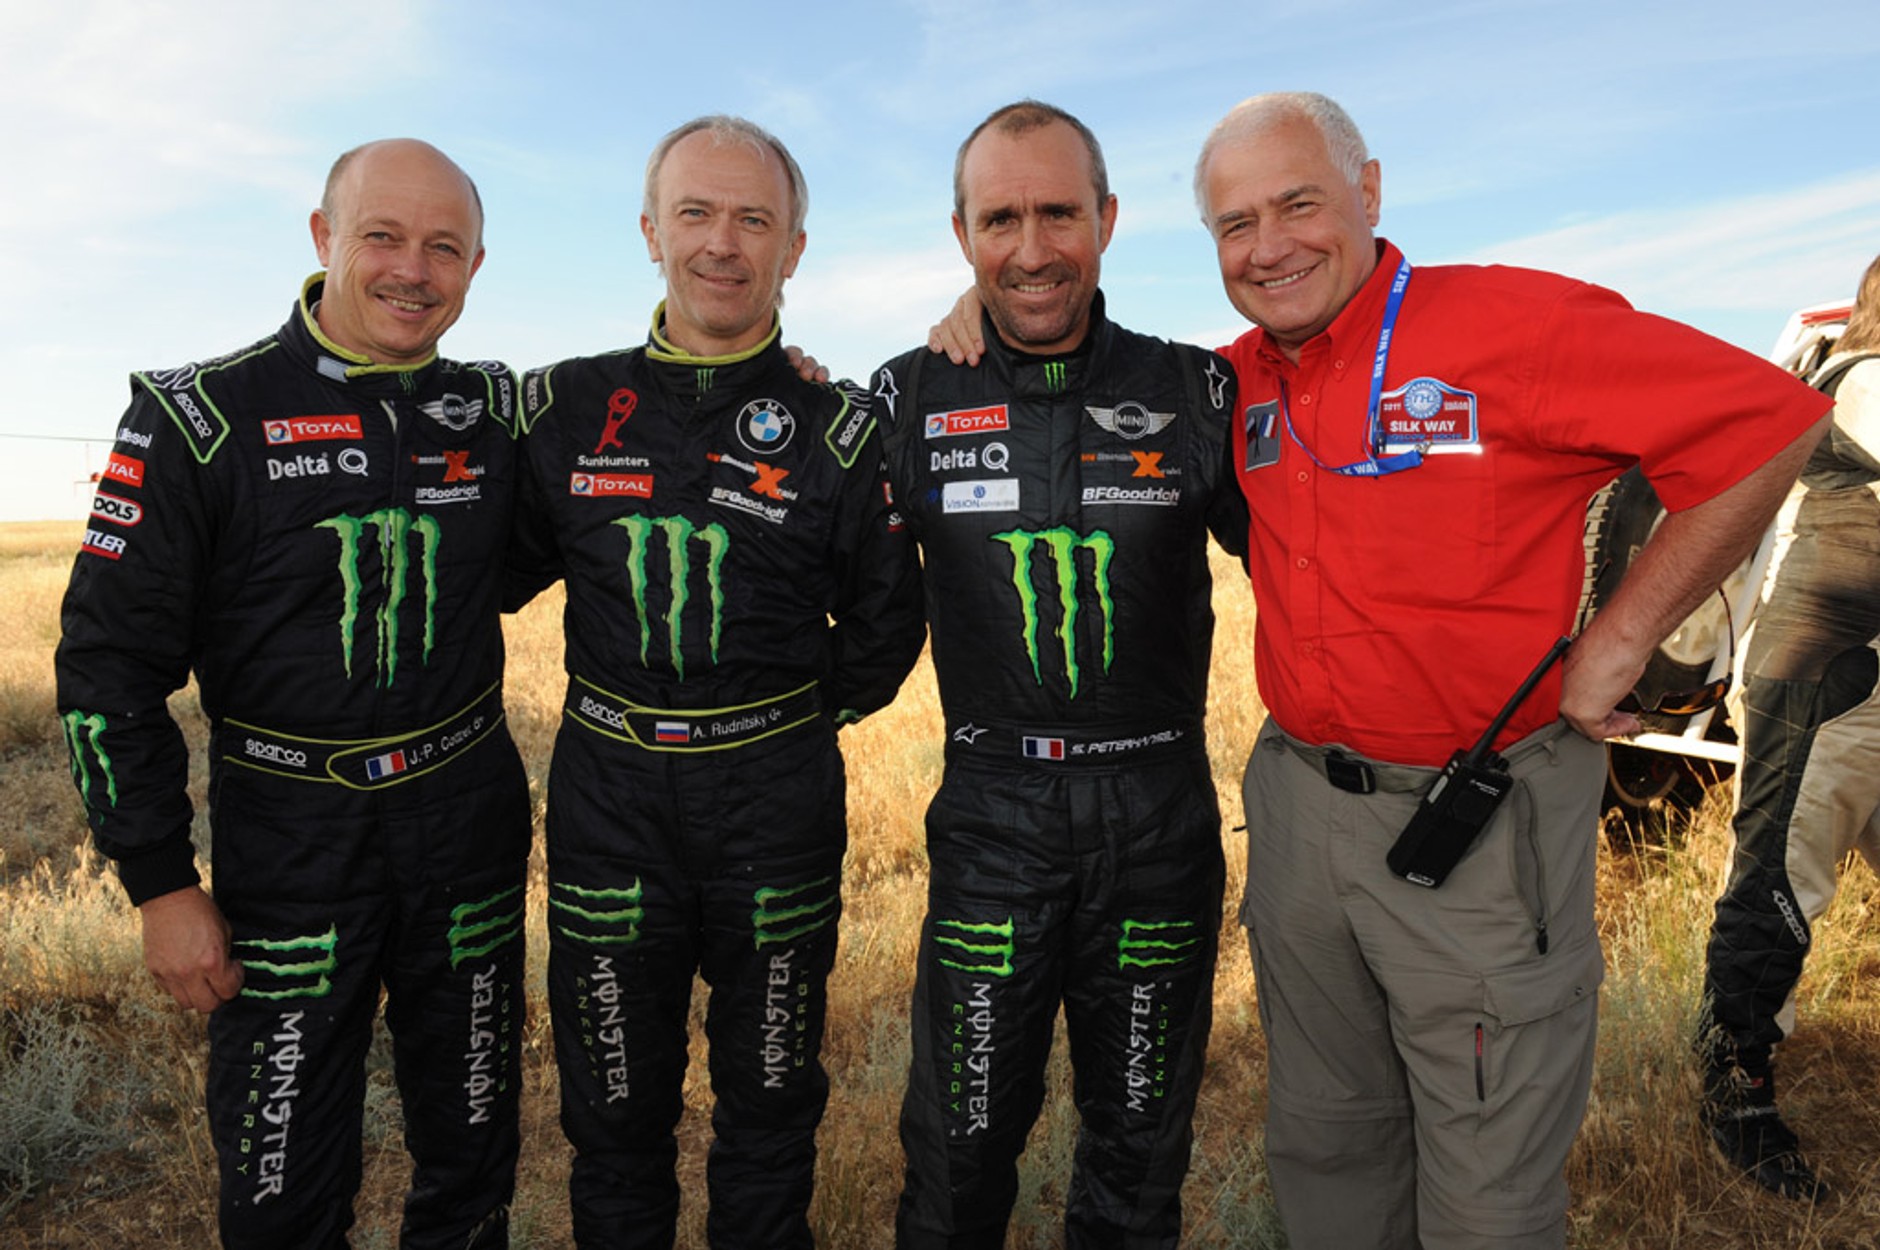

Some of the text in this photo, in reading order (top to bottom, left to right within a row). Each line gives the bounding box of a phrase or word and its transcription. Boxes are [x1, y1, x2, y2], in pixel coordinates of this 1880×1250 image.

[173, 392, 212, 439] sparco
[291, 422, 360, 436] TOTAL
[948, 413, 1006, 430] TOTAL
[1116, 415, 1147, 428] MINI
[1389, 420, 1456, 433] SILK WAY
[267, 453, 330, 481] Delta
[577, 454, 650, 468] SunHunters
[930, 448, 977, 472] Delta
[594, 478, 650, 493] TOTAL
[1082, 485, 1181, 502] BFGoodrich
[579, 696, 624, 730] sparco
[692, 725, 707, 739] A.
[711, 714, 767, 737] Rudnitsky
[245, 738, 307, 768] sparco
[590, 955, 630, 1104] MONSTER
[760, 948, 795, 1088] MONSTER
[464, 963, 497, 1125] MONSTER
[950, 1003, 964, 1112] ENERGY
[966, 981, 996, 1136] MONSTER
[1125, 981, 1156, 1112] MONSTER
[1153, 1003, 1168, 1098] ENERGY
[236, 1042, 265, 1176] ENERGY
[252, 1009, 306, 1205] MONSTER
